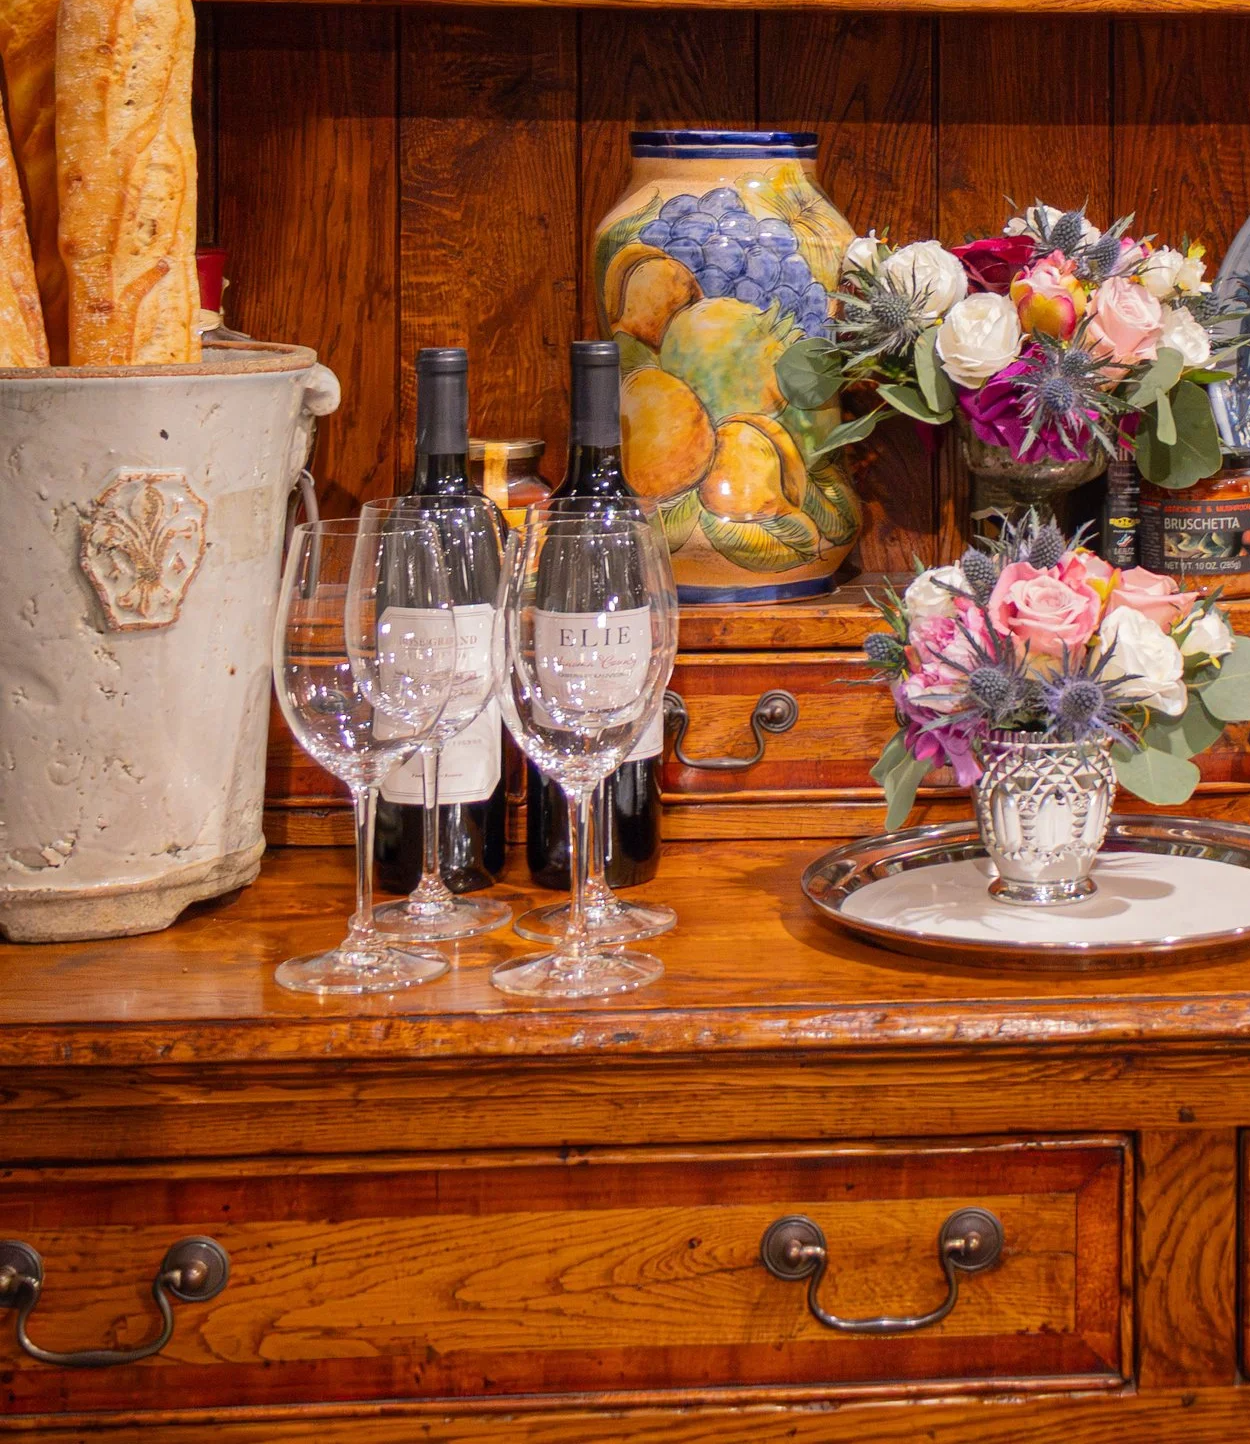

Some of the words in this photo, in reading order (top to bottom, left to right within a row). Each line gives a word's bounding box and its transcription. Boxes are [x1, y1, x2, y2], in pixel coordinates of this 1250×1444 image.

[1164, 517, 1240, 531] BRUSCHETTA
[1195, 562, 1204, 570] 10
[560, 626, 632, 648] ELIE
